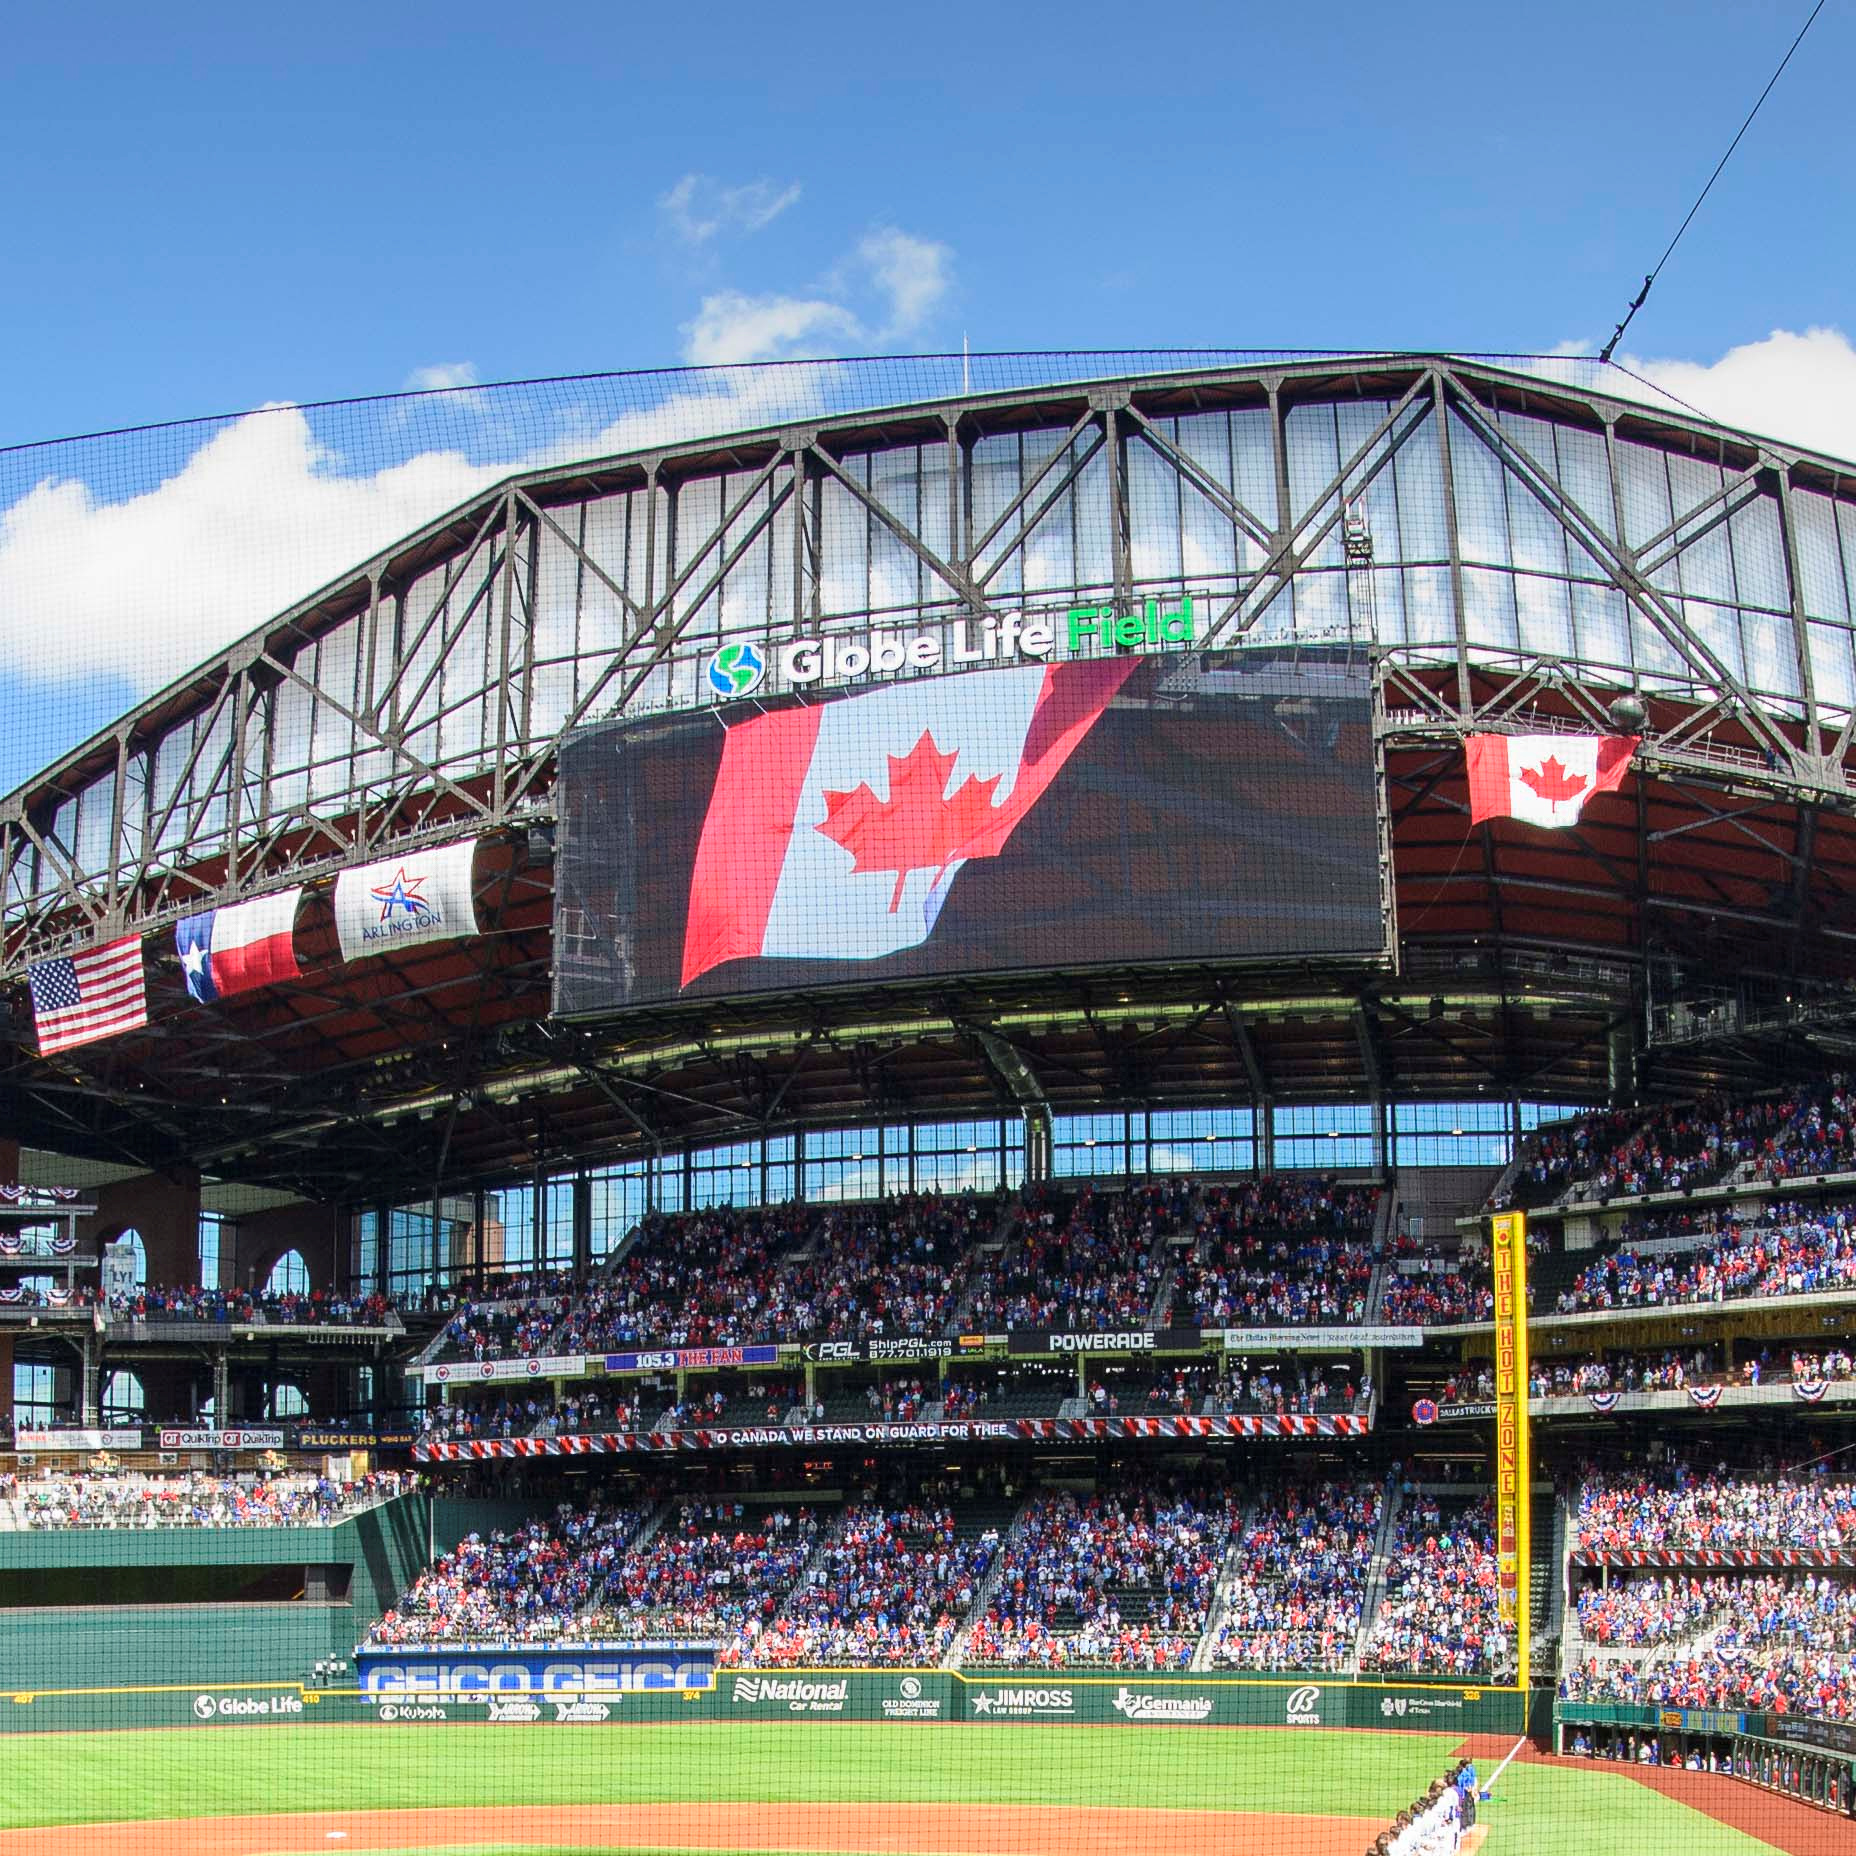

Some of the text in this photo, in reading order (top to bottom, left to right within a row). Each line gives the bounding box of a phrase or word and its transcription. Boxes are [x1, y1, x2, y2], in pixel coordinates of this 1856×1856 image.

[780, 597, 1196, 683] Globe Life Field
[363, 912, 441, 942] ARLINGTON
[1498, 1250, 1513, 1315] THE
[819, 1341, 855, 1357] PGL
[869, 1338, 952, 1349] ShipPGL.com
[1049, 1332, 1157, 1351] POWERADE
[636, 1348, 745, 1369] 105.3 THE FAN
[869, 1347, 952, 1359] 877.701.1919
[1499, 1325, 1514, 1393] HOT
[182, 1433, 221, 1448] QuikTrip
[242, 1433, 281, 1448] QuikTrip
[301, 1434, 377, 1446] PLUCKERS
[717, 1424, 1007, 1444] O CANADA WE STAND ON GUARD FOR THEE
[1501, 1403, 1515, 1494] ZONE
[366, 1662, 712, 1692] GEICO GEICO
[683, 1690, 701, 1701] 374
[1141, 1695, 1212, 1711] Germania
[218, 1695, 302, 1715] Globe Life
[400, 1705, 447, 1720] Kubota
[789, 1701, 844, 1711] Car Rental
[881, 1700, 940, 1709] OLD DOMINION
[920, 1708, 938, 1717] LINE
[1286, 1713, 1320, 1724] SPORTS
